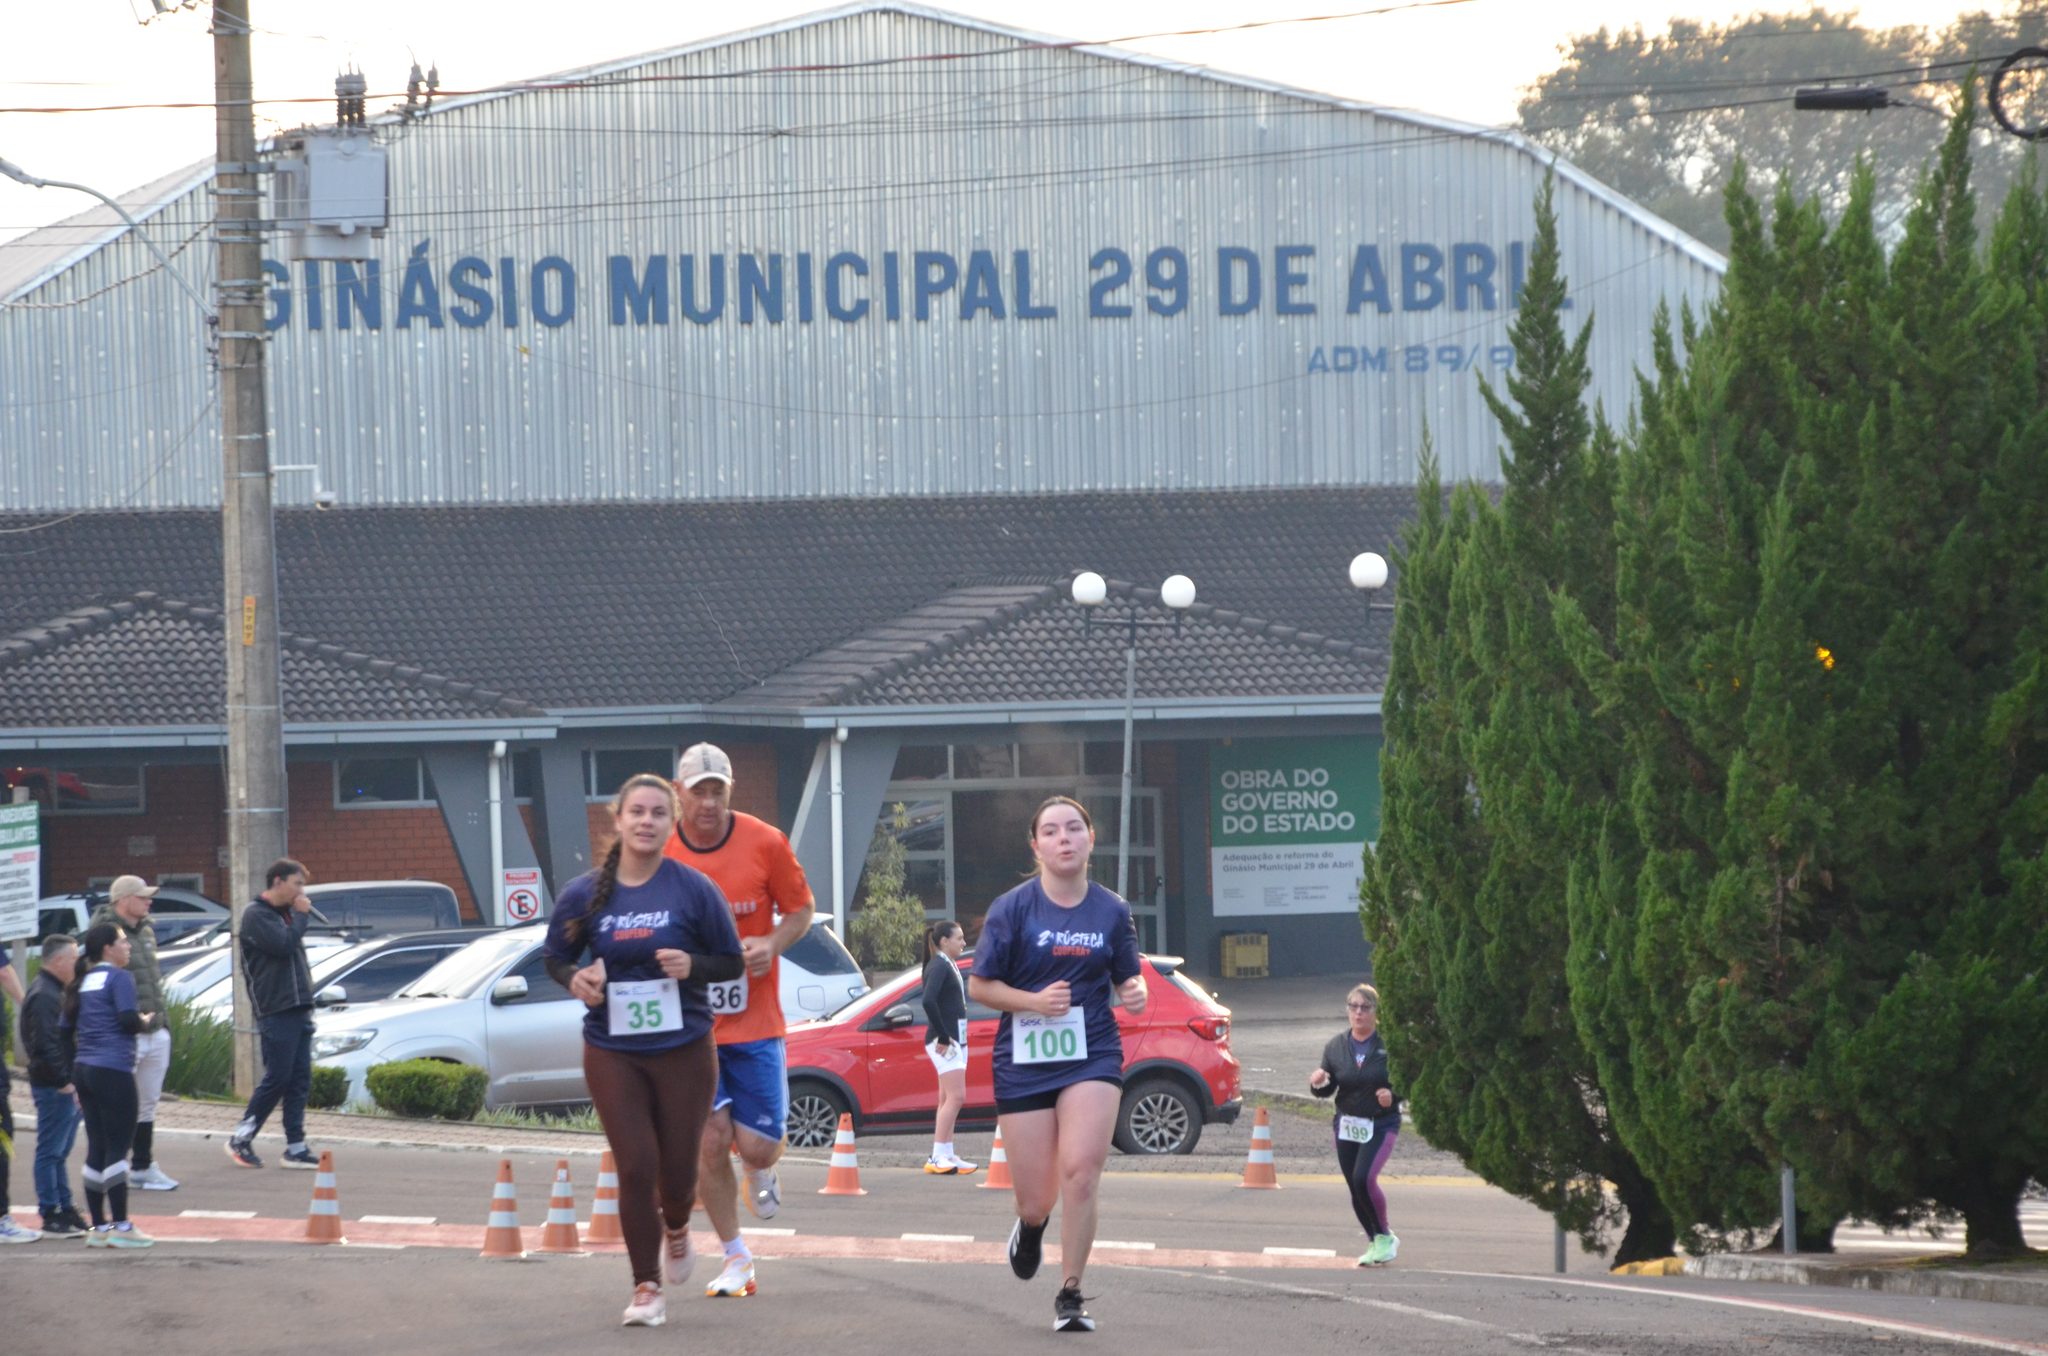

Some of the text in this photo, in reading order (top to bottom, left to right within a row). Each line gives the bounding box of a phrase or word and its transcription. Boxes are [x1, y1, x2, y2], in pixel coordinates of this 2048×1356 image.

[264, 238, 1574, 331] GINÁSIO MUNICIPAL 29 DE ABRI
[1307, 342, 1516, 374] ADM 89/9
[1221, 768, 1329, 789] OBRA DO
[1221, 790, 1338, 812] GOVERNO
[1222, 811, 1355, 834] DO ESTADO
[1222, 852, 1273, 863] Adequação
[1283, 851, 1319, 860] reforma
[1222, 863, 1256, 872] Ginásio
[1259, 862, 1302, 872] Municipal
[1304, 862, 1315, 870] 29
[1332, 860, 1354, 869] Abril
[711, 985, 742, 1009] 36
[627, 1000, 663, 1029] 35
[1024, 1028, 1077, 1059] 100
[1345, 1125, 1369, 1140] 199
